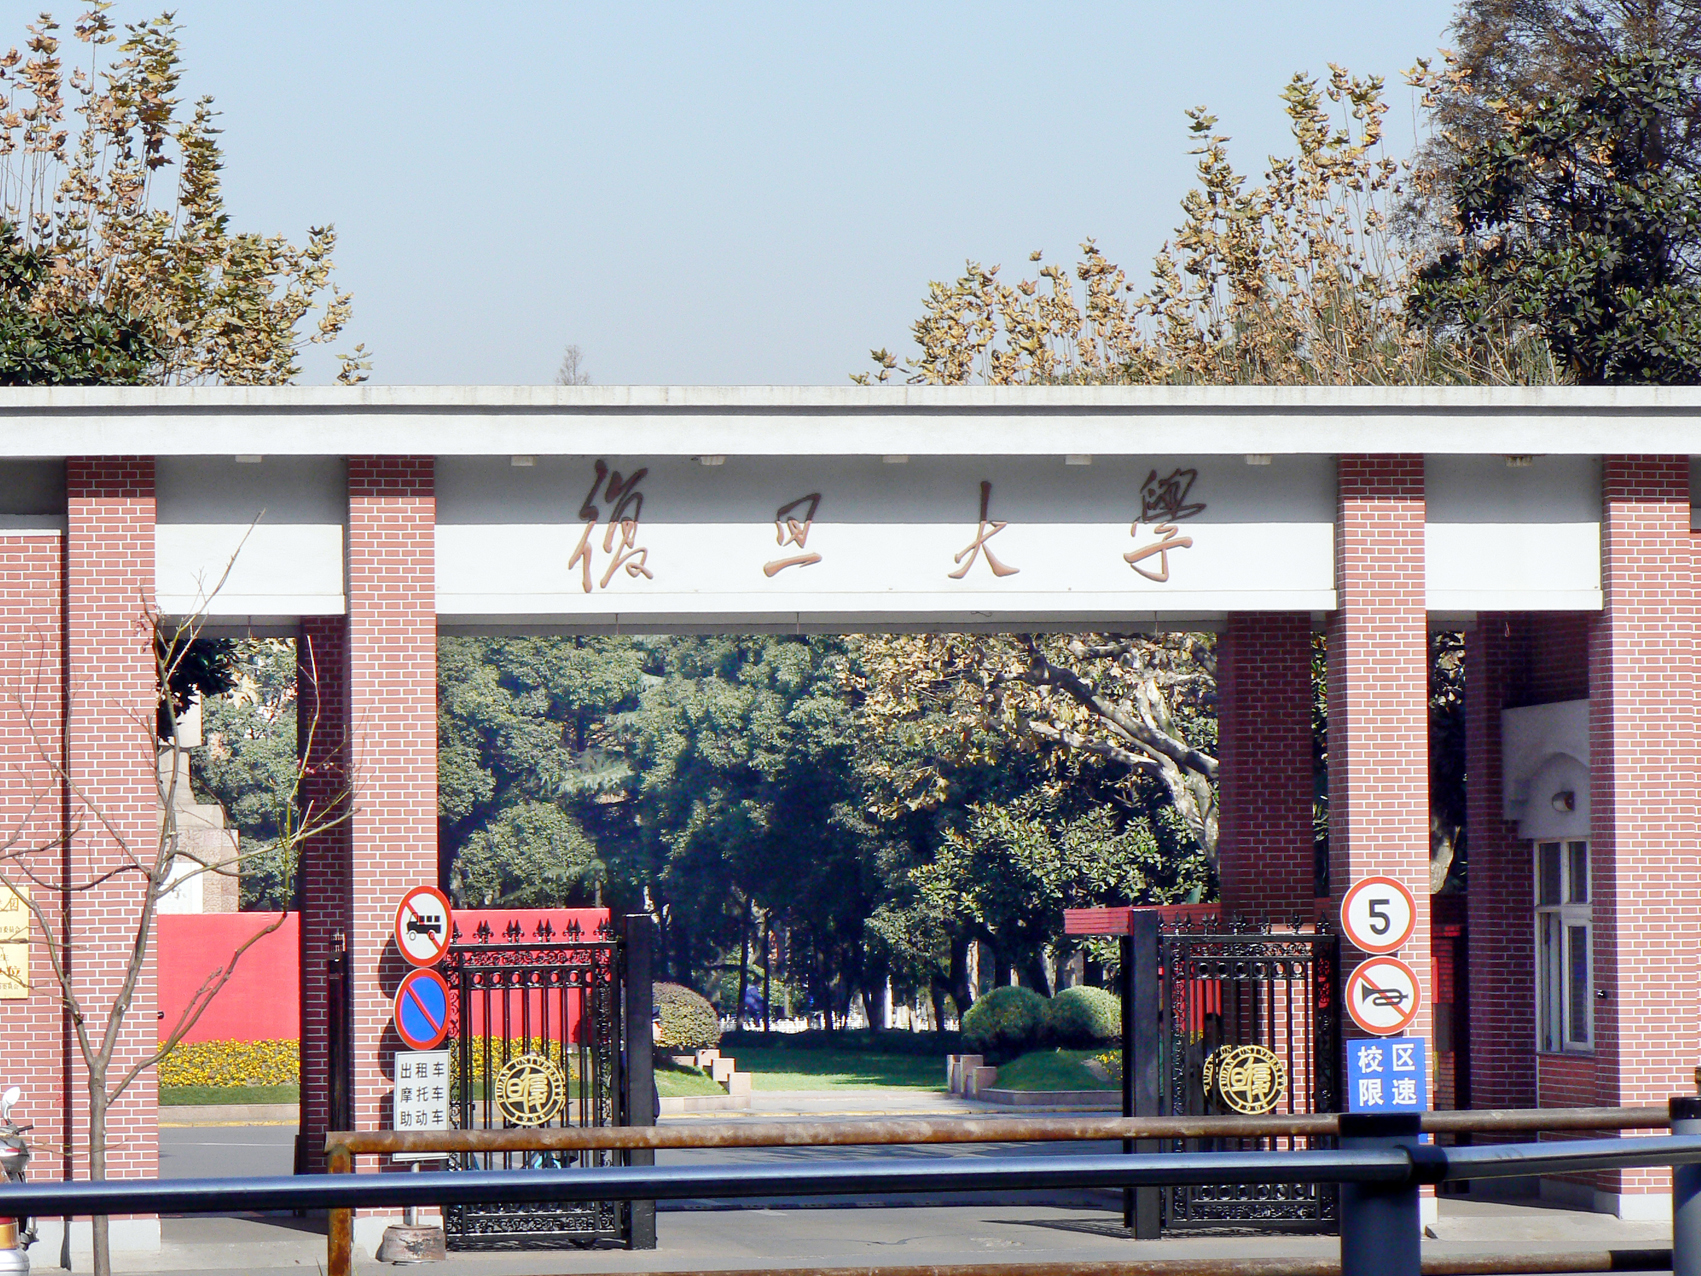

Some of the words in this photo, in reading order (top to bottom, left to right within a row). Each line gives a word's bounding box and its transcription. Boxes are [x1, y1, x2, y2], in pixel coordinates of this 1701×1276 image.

[1369, 899, 1390, 935] 5
[1357, 1043, 1416, 1073] 校区
[400, 1062, 444, 1078] 出租车
[400, 1086, 444, 1103] 摩托车
[1358, 1077, 1417, 1106] 限速
[400, 1109, 444, 1126] 助动车
